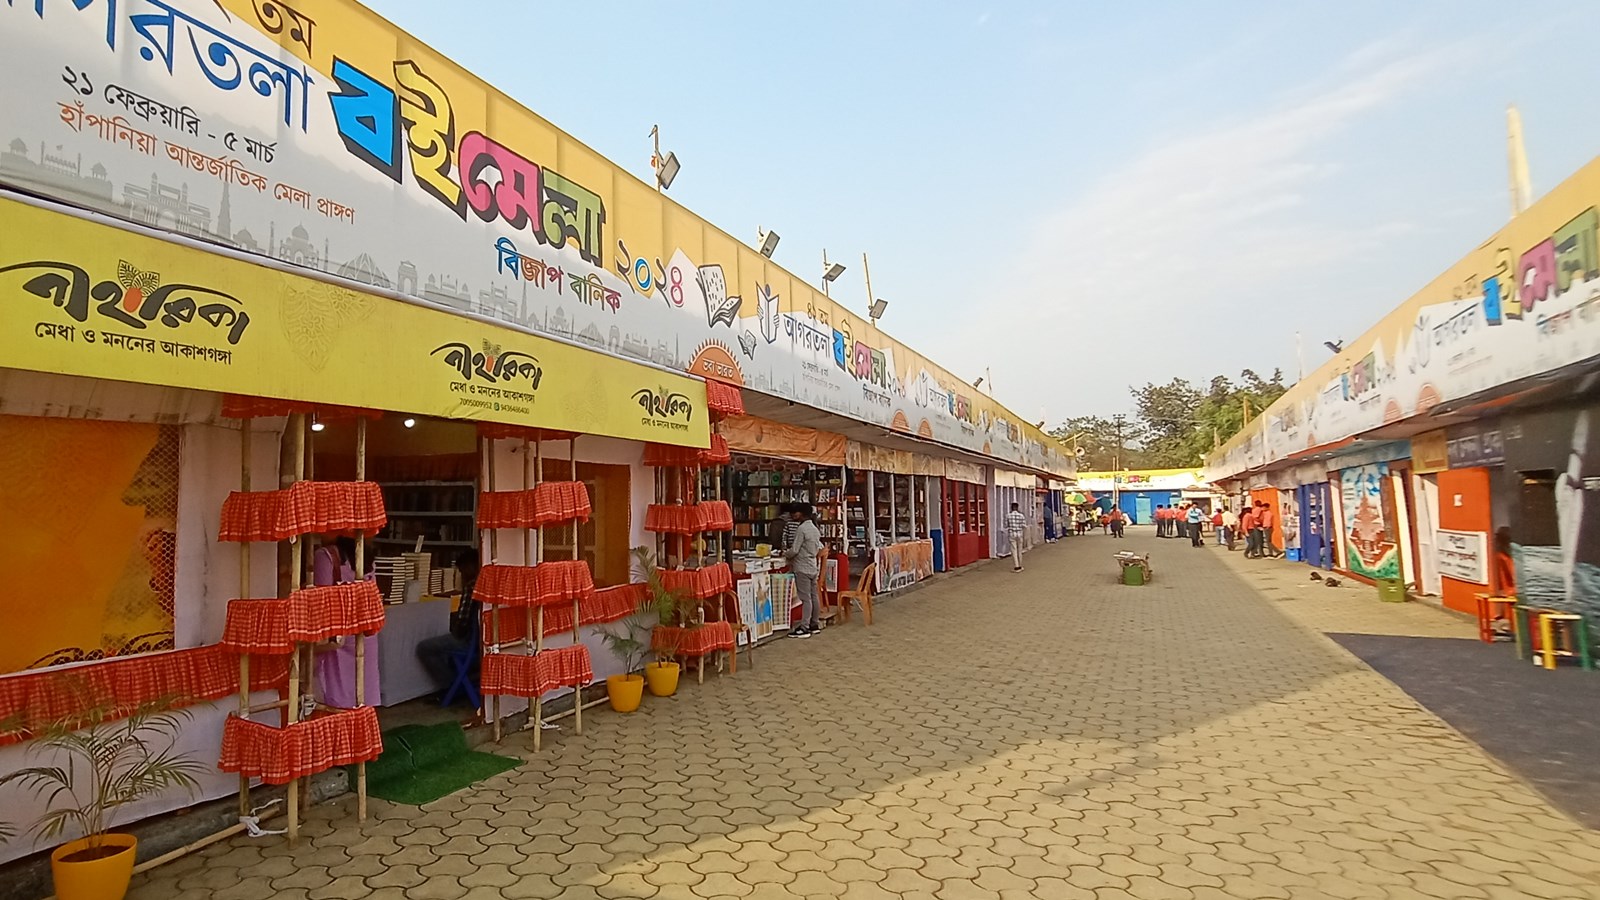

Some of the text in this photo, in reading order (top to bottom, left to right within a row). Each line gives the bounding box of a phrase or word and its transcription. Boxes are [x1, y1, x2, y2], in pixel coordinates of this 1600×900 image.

[7, 0, 684, 309] রতলা বইমেলা ২০২৪
[56, 100, 355, 226] হাঁপানিয়া আন্তর্জাতিক মেলা প্রাঙ্গণ
[62, 65, 94, 97] ২১
[104, 83, 201, 138] ফেব্রুয়ারি
[223, 131, 238, 154] ৫
[243, 136, 278, 164] মার্চ
[35, 322, 232, 365] মেধা ও মননের আকাশগঙ্গা
